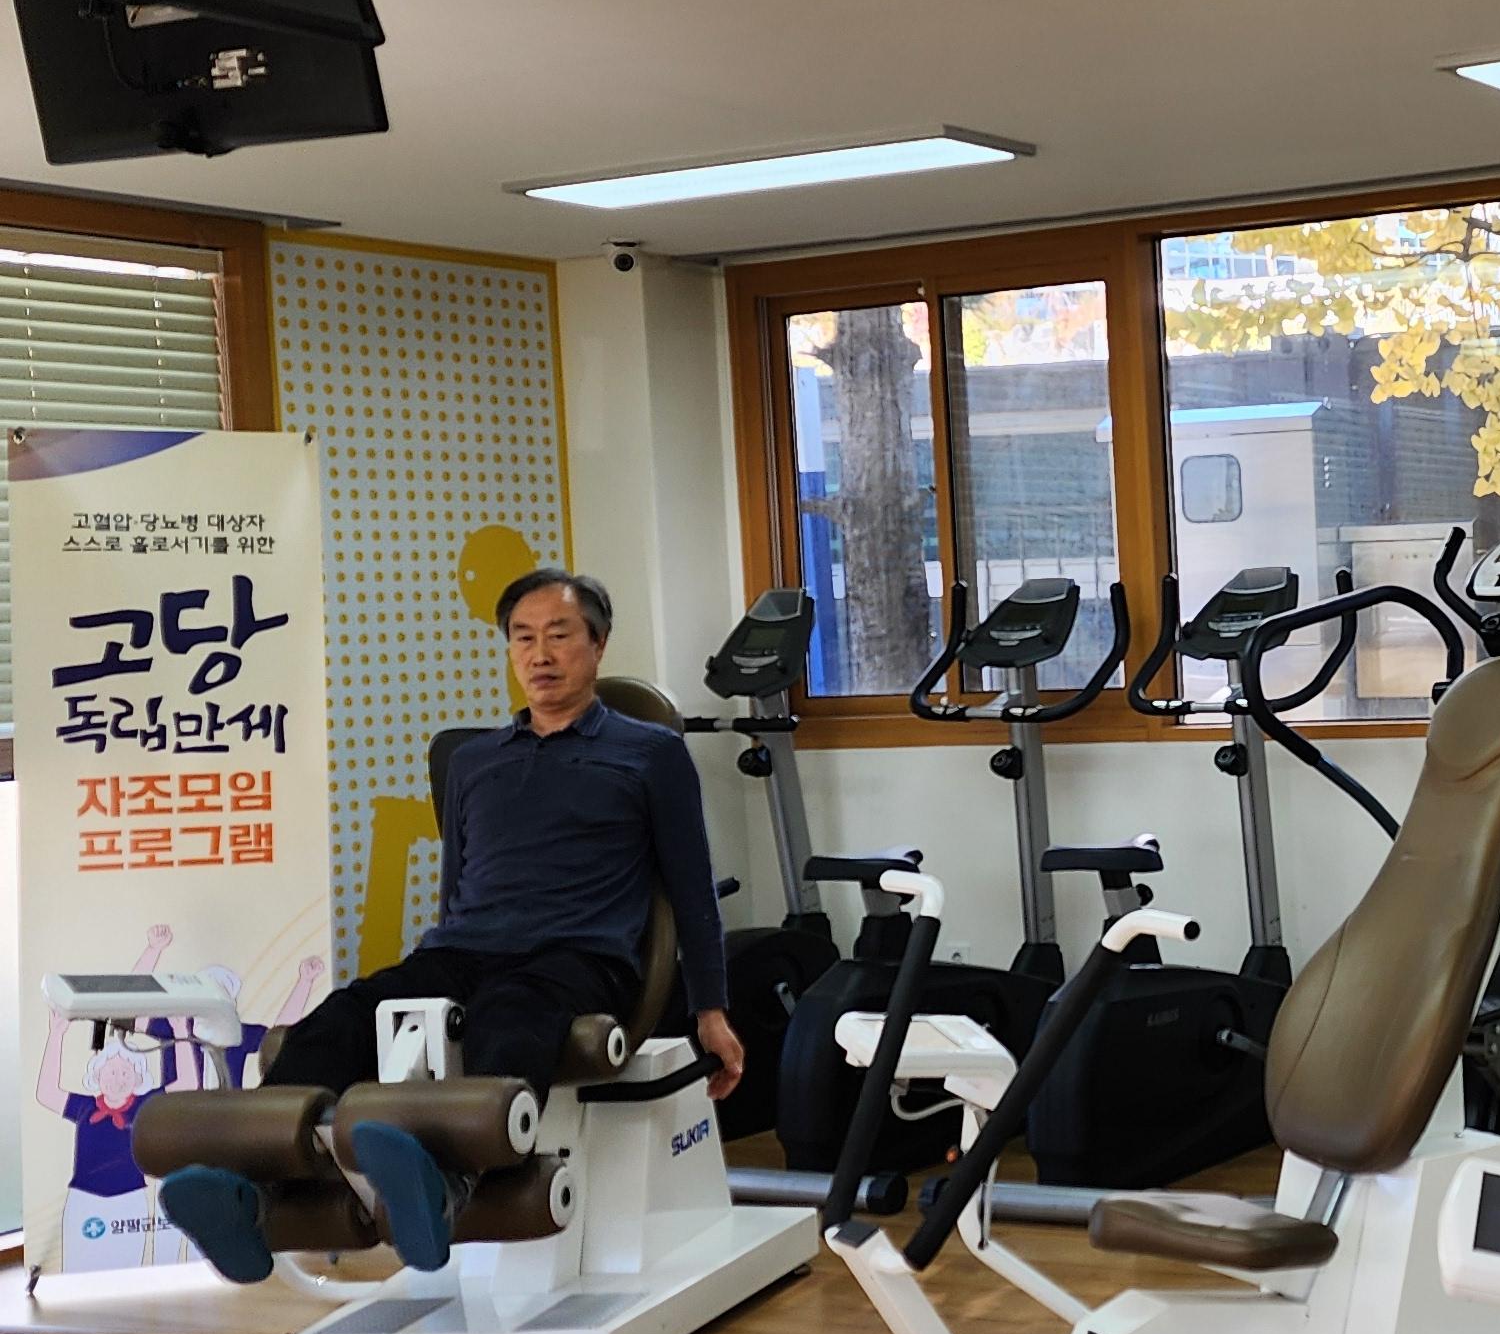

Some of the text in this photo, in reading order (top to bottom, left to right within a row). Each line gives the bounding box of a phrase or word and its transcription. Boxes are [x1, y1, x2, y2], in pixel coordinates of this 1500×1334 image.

[62, 535, 123, 552] 스스로
[236, 535, 275, 554] 위한
[207, 513, 265, 533] 대상자
[51, 574, 289, 695] 고당
[55, 693, 289, 755] 독립만세
[76, 770, 273, 818] 자조모임
[77, 822, 274, 873] 프로그램
[671, 1119, 709, 1157] SUKIA
